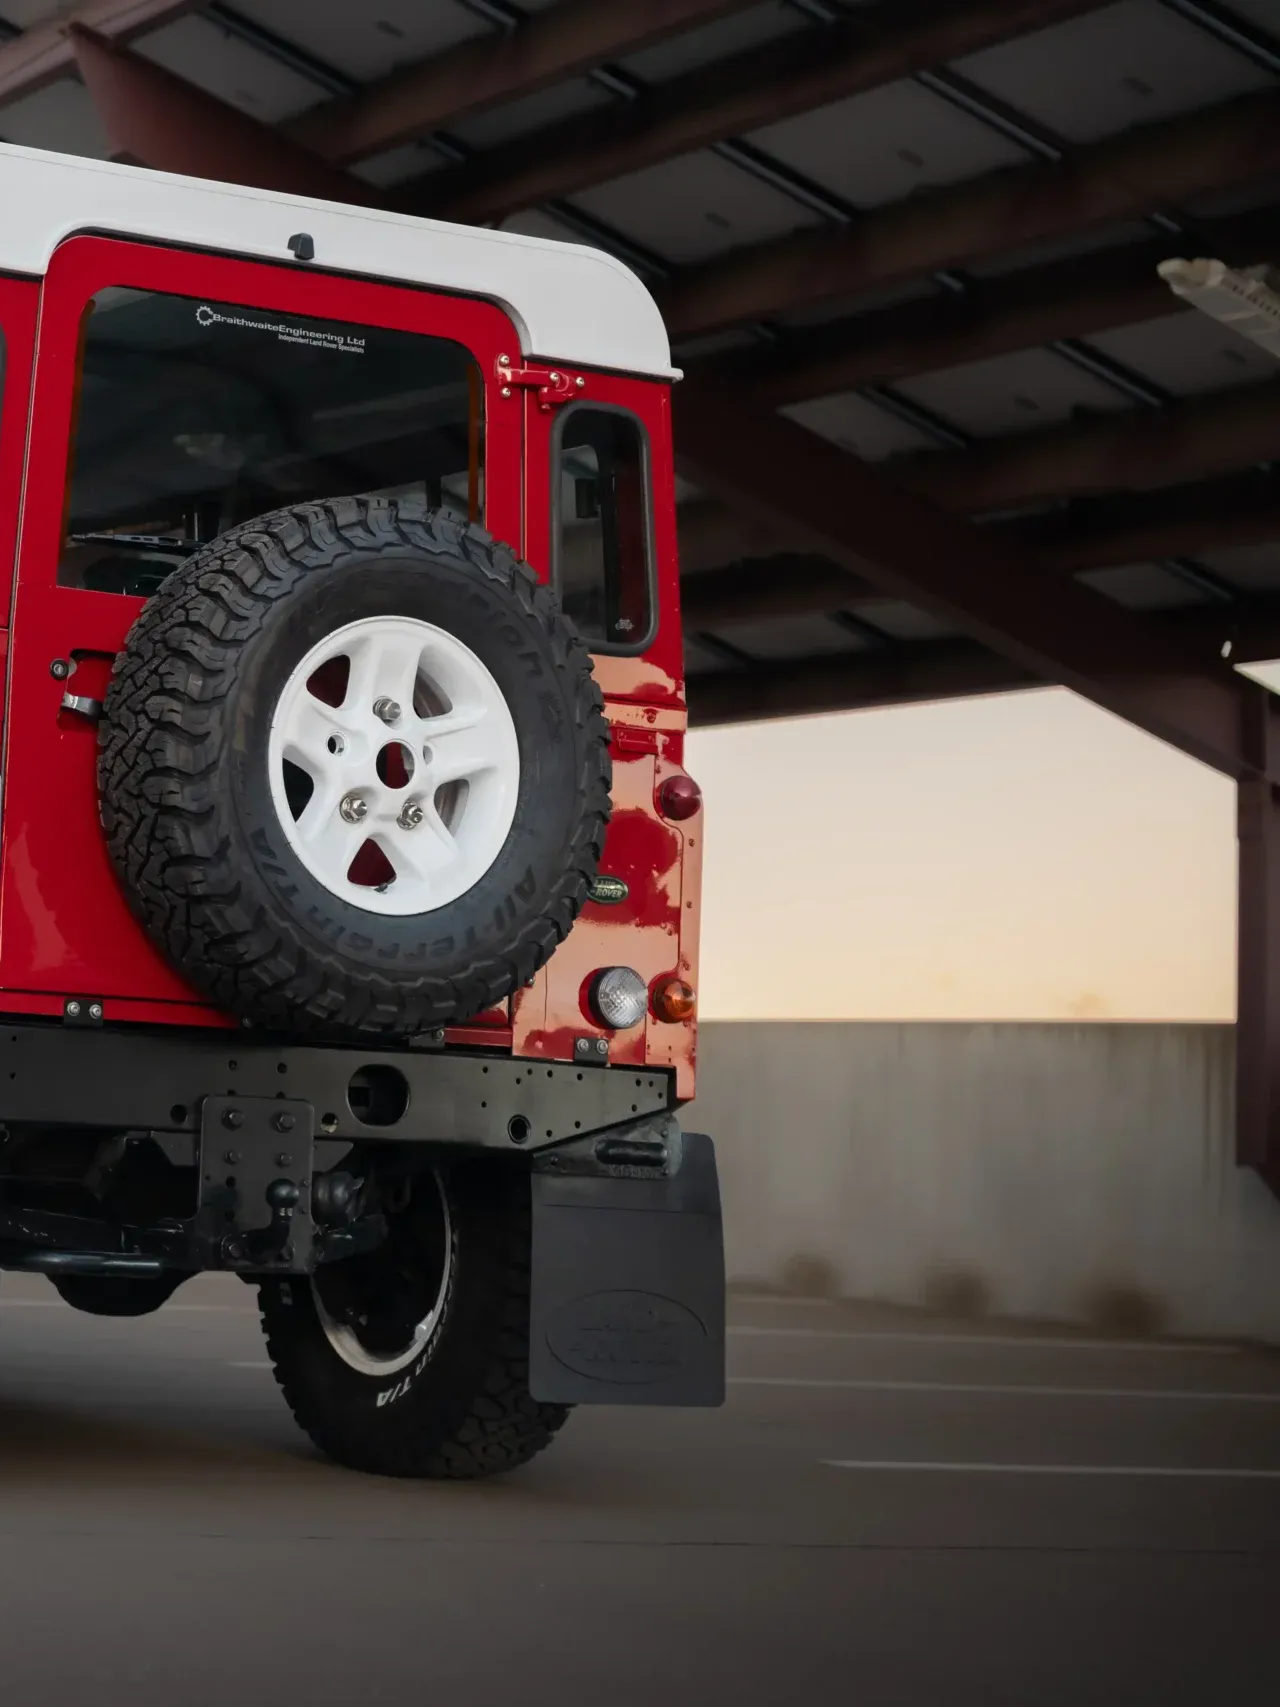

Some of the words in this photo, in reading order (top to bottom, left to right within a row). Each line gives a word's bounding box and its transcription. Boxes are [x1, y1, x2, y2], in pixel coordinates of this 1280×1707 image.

[278, 333, 309, 344] Independent
[310, 338, 323, 347] Land
[323, 341, 338, 349] Rover
[338, 343, 365, 354] Specialists
[347, 336, 366, 347] Ltd
